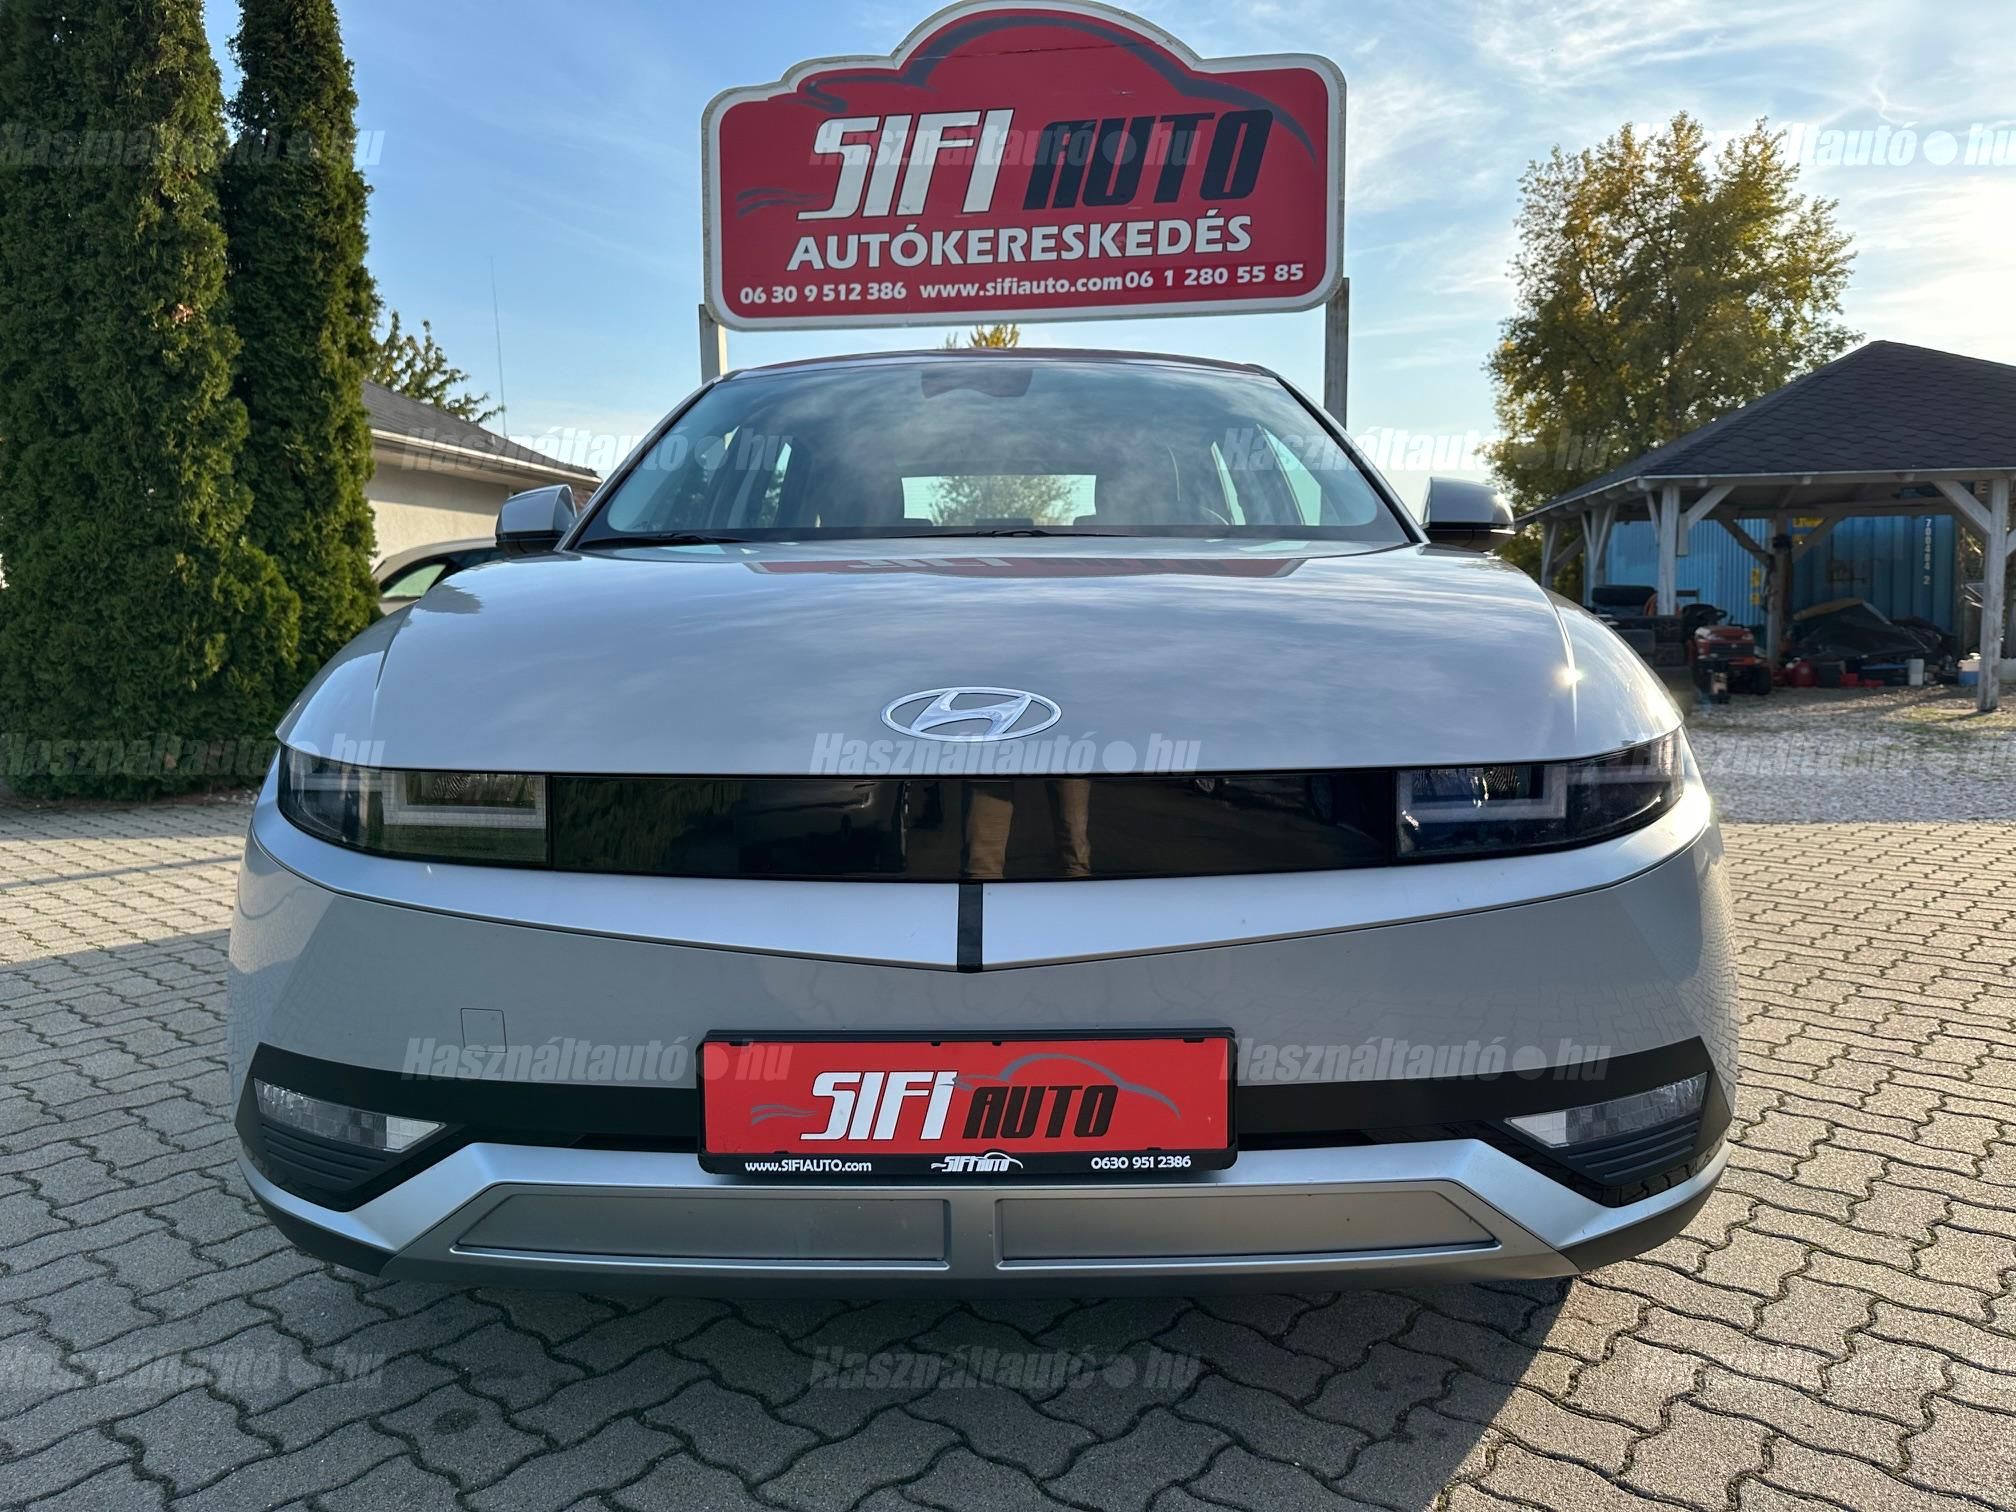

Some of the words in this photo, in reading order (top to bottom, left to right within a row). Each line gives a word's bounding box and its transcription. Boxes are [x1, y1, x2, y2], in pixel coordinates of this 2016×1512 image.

[798, 107, 1015, 222] SIFI
[1022, 108, 1273, 211] AUTO
[785, 208, 1252, 271] AUTÓKERESKEDÉS
[740, 287, 767, 304] 06
[771, 286, 797, 303] 30
[822, 284, 861, 301] 512
[866, 282, 907, 300] 386
[919, 275, 1123, 298] www.sifiauto.com
[1125, 271, 1154, 288] 06
[1163, 270, 1174, 286] 1
[1184, 267, 1229, 286] 280
[1237, 265, 1266, 283] 55
[1274, 263, 1304, 281] 85
[800, 1069, 959, 1142] SIFI
[962, 1084, 1119, 1140] AUTO
[745, 1159, 872, 1172] www.SIFIAUTO.com
[1091, 1156, 1129, 1170] 0630
[1132, 1156, 1154, 1169] 951
[1157, 1155, 1192, 1168] 2386
